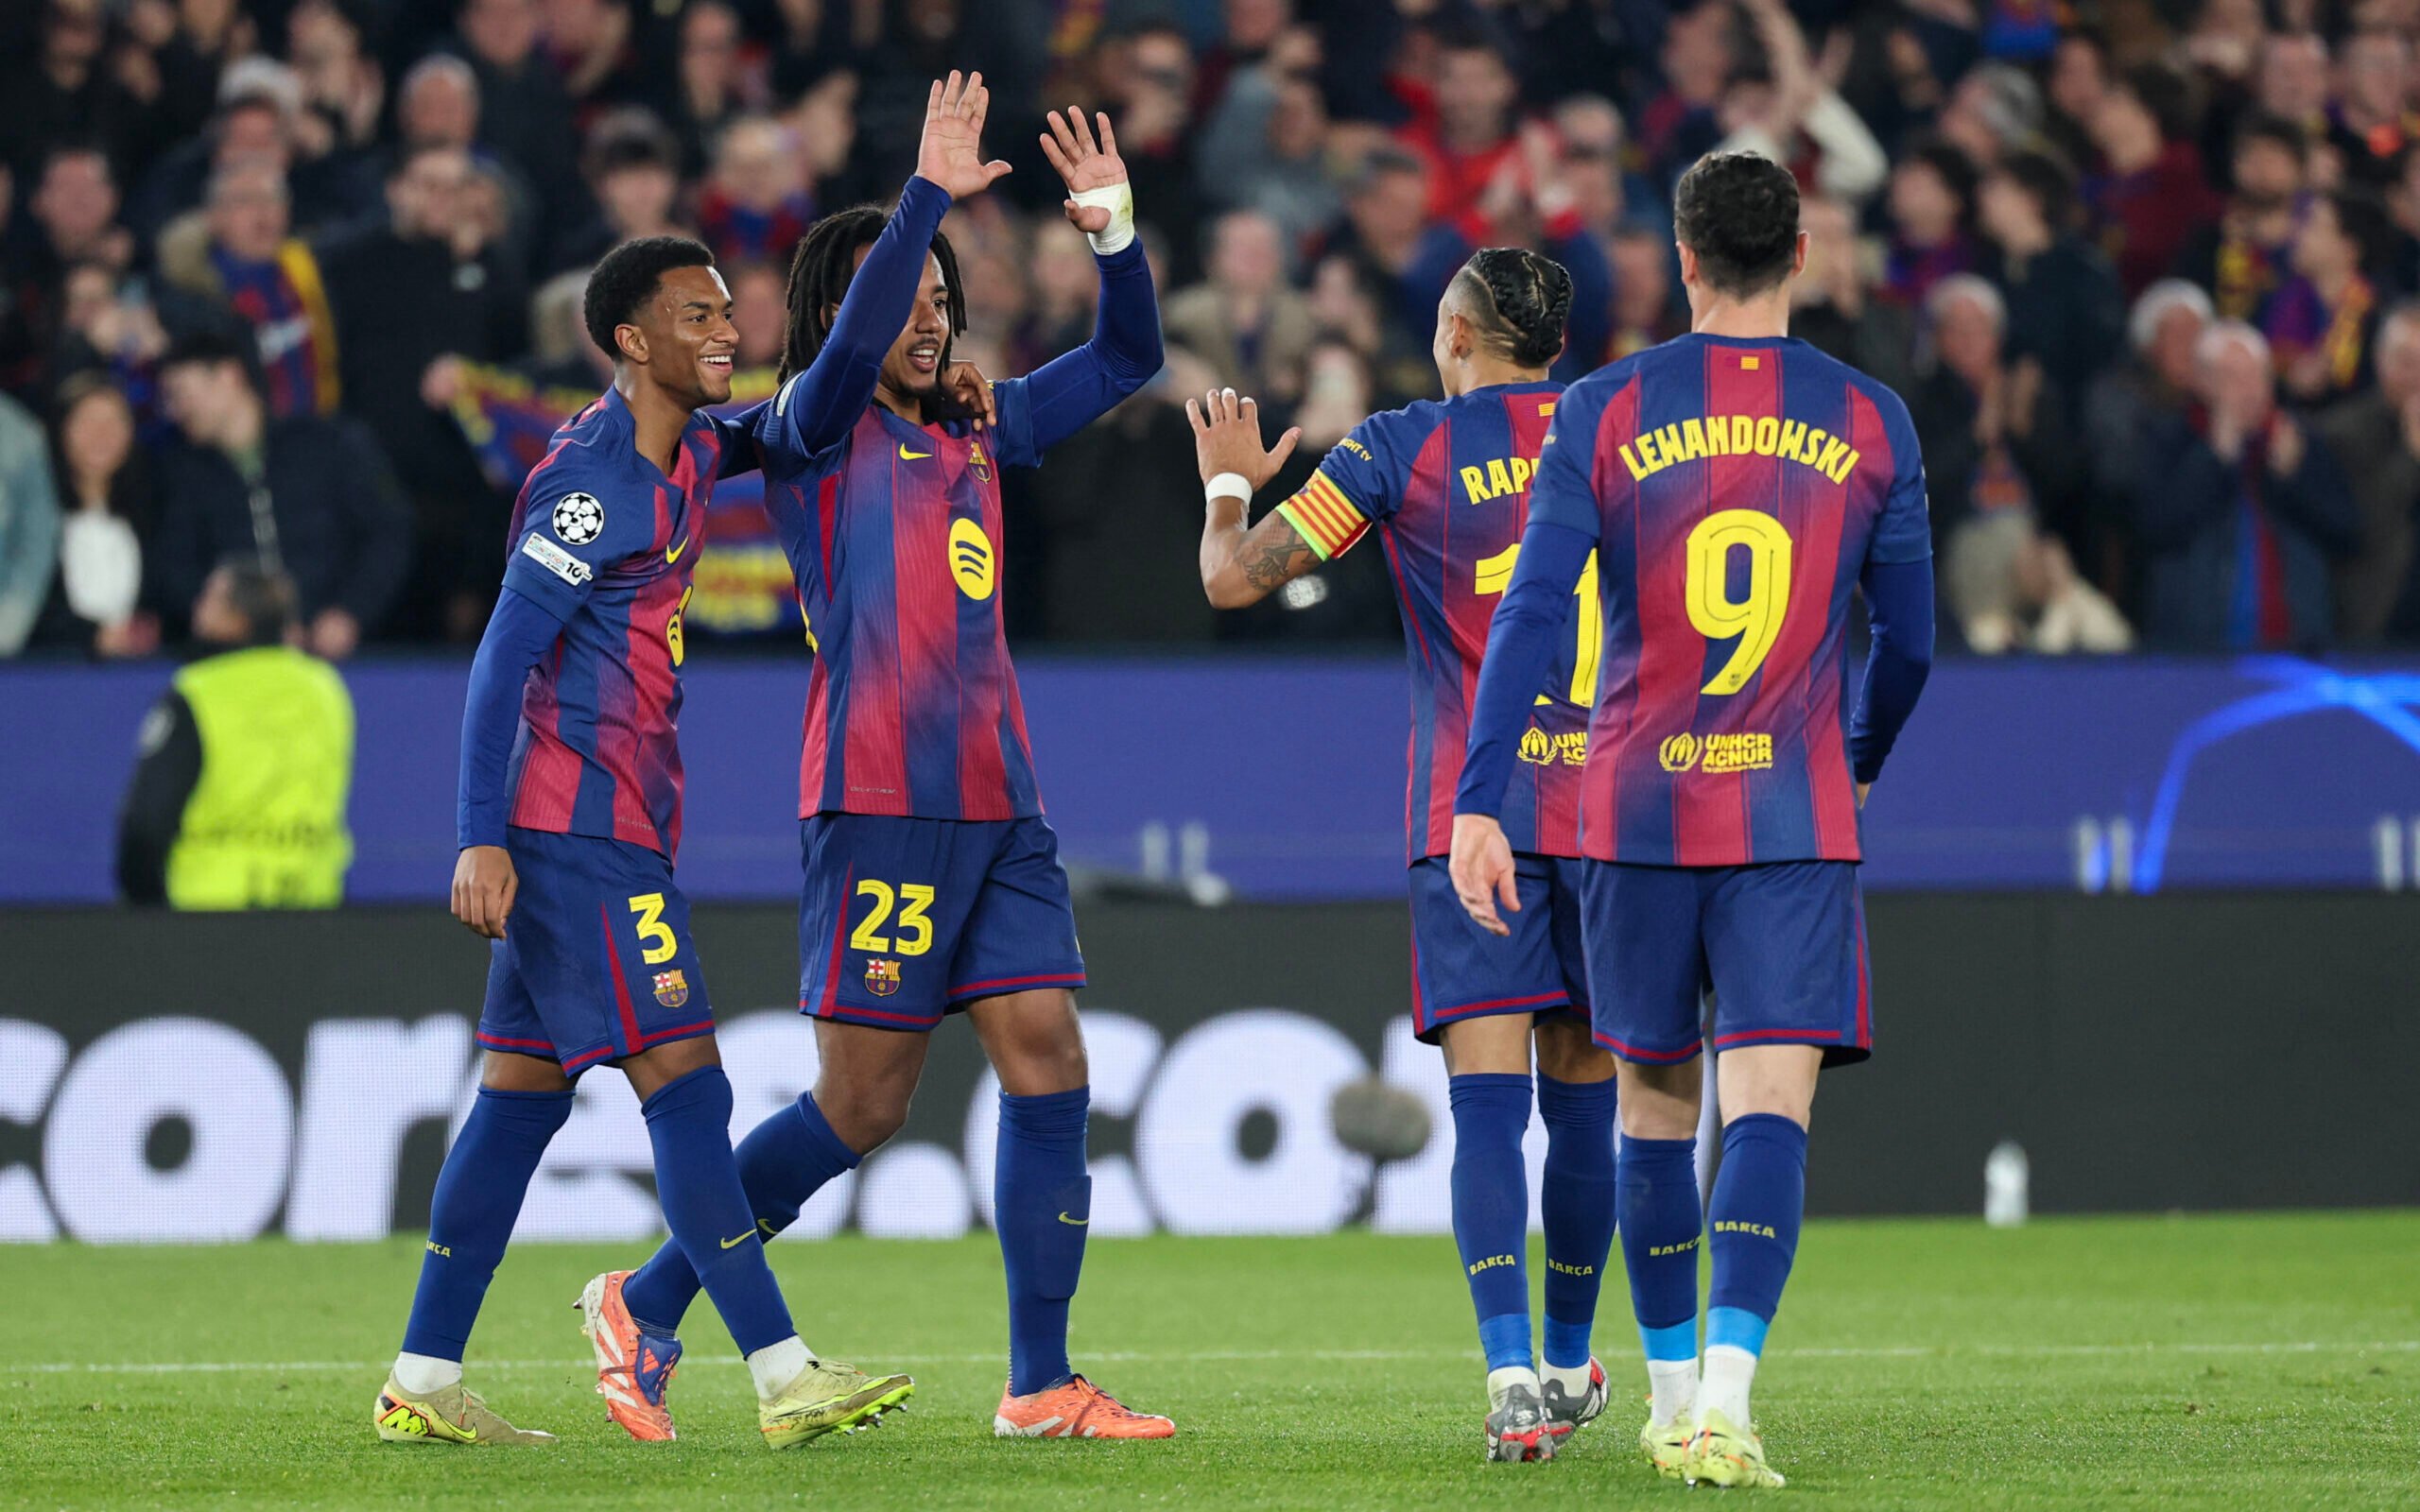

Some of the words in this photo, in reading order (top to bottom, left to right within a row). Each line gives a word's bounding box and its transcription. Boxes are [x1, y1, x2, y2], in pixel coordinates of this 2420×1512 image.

[1618, 414, 1860, 485] LEWANDOWSKI
[1459, 456, 1541, 506] RAP
[1685, 508, 1793, 695] 9
[1703, 747, 1773, 768] ACNUR
[1704, 733, 1772, 750] UNHCR
[629, 892, 678, 965] 3
[850, 879, 935, 956] 23
[1714, 1221, 1775, 1239] BARÇA
[1469, 1254, 1516, 1276] BARÇA
[1548, 1257, 1594, 1277] BARÇA
